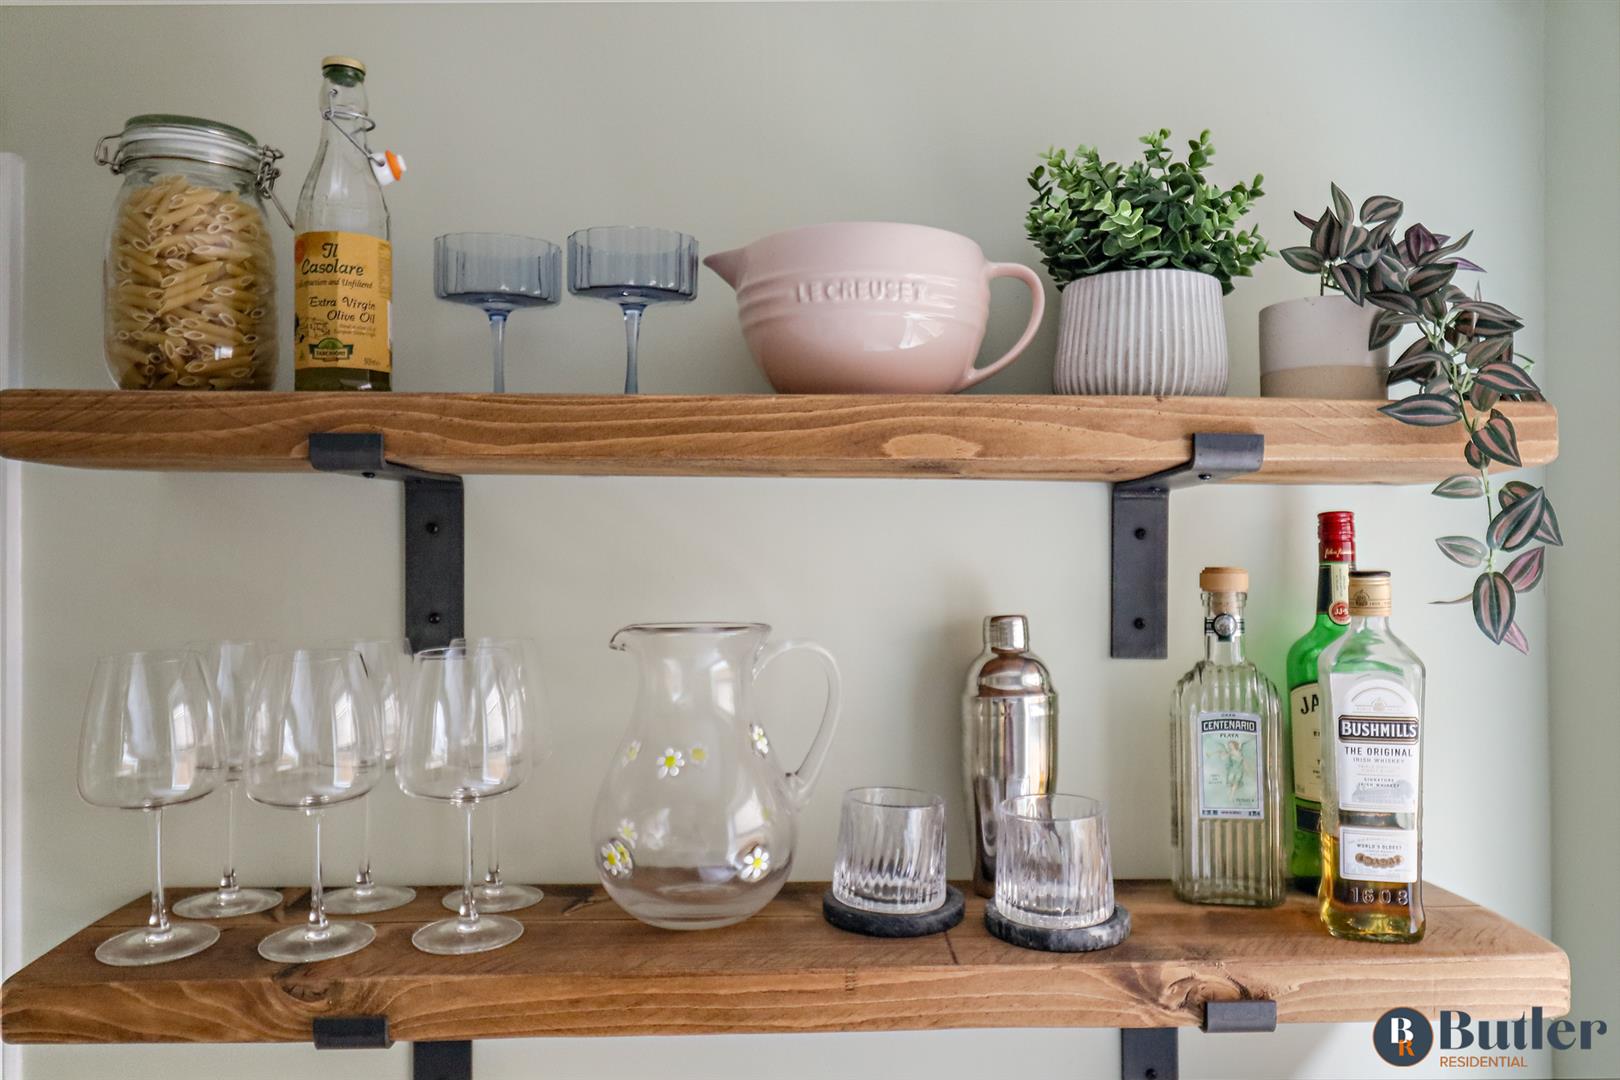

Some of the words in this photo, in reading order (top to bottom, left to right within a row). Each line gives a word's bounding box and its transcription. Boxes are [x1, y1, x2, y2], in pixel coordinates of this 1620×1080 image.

[322, 243, 339, 258] Il
[301, 258, 364, 276] Casolare
[309, 296, 337, 307] Extra
[342, 296, 376, 311] Virgin
[327, 310, 356, 321] Olive
[359, 311, 376, 324] Oil
[1203, 720, 1255, 731] CENTENARIO
[1341, 721, 1417, 738] BUSHMILLS
[1345, 746, 1363, 756] THE
[1367, 747, 1413, 758] ORIGINAL
